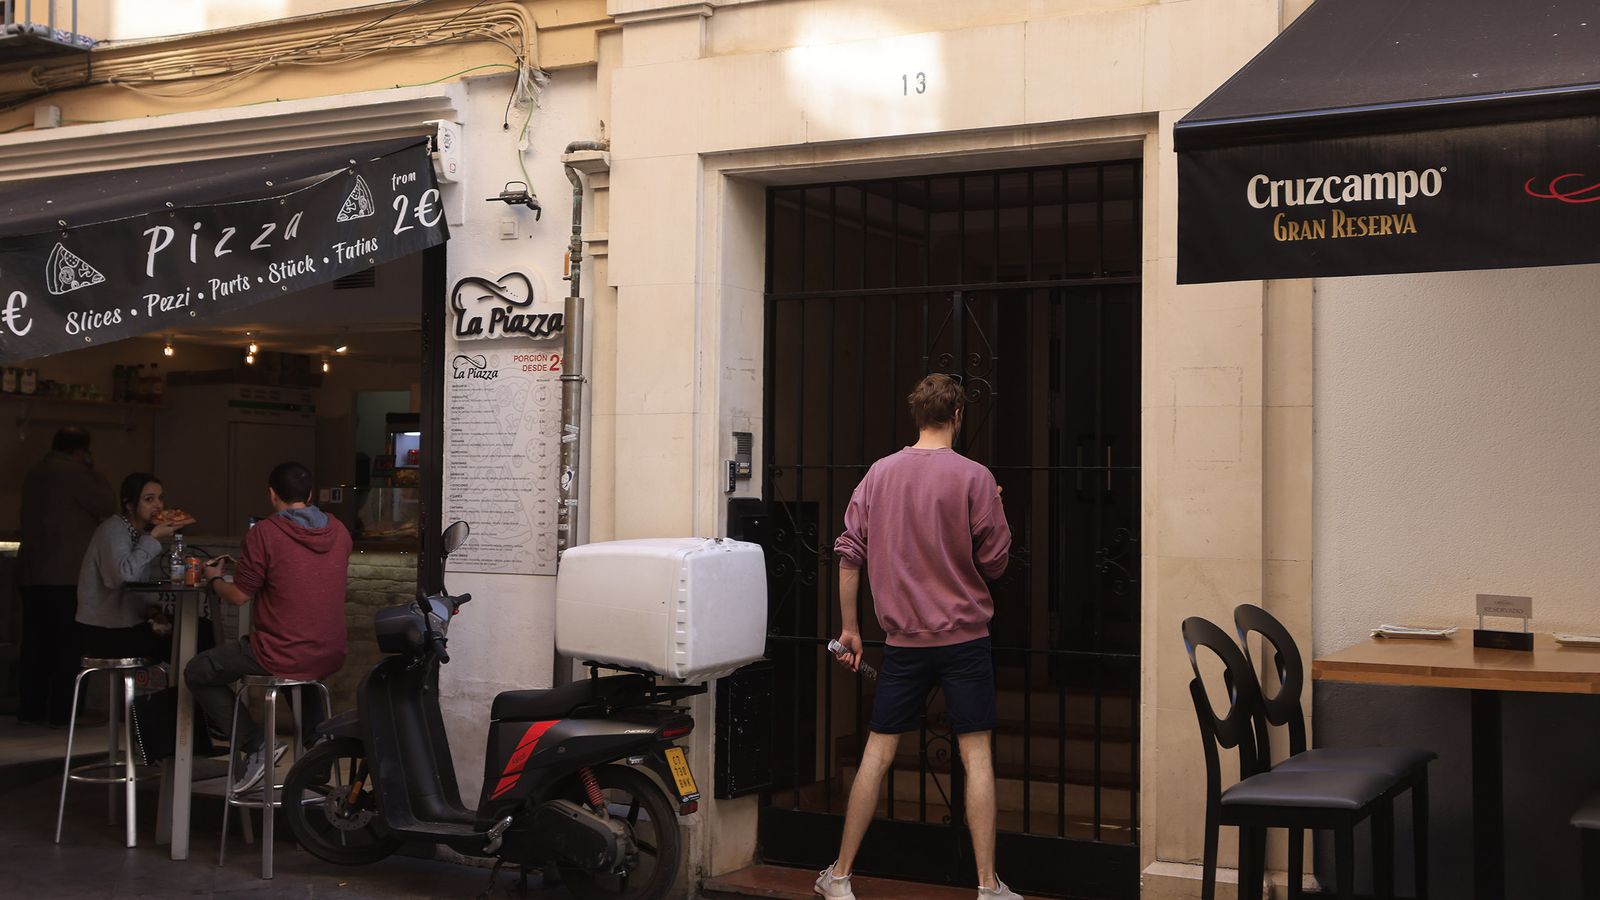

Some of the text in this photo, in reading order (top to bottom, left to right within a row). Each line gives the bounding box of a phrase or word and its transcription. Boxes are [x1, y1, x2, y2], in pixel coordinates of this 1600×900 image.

[902, 72, 926, 96] 13
[391, 171, 416, 191] from
[392, 188, 443, 236] 2€
[1273, 209, 1418, 242] GRAN RESERVA
[143, 211, 303, 278] Pizza
[65, 308, 122, 335] Slices
[143, 287, 191, 317] Pezzi
[208, 274, 250, 300] Parts
[268, 255, 316, 284] Stück
[455, 305, 564, 337] La Piazza
[513, 352, 548, 363] PORCIÓN
[522, 364, 548, 372] DESDE
[453, 367, 499, 380] La Piazza
